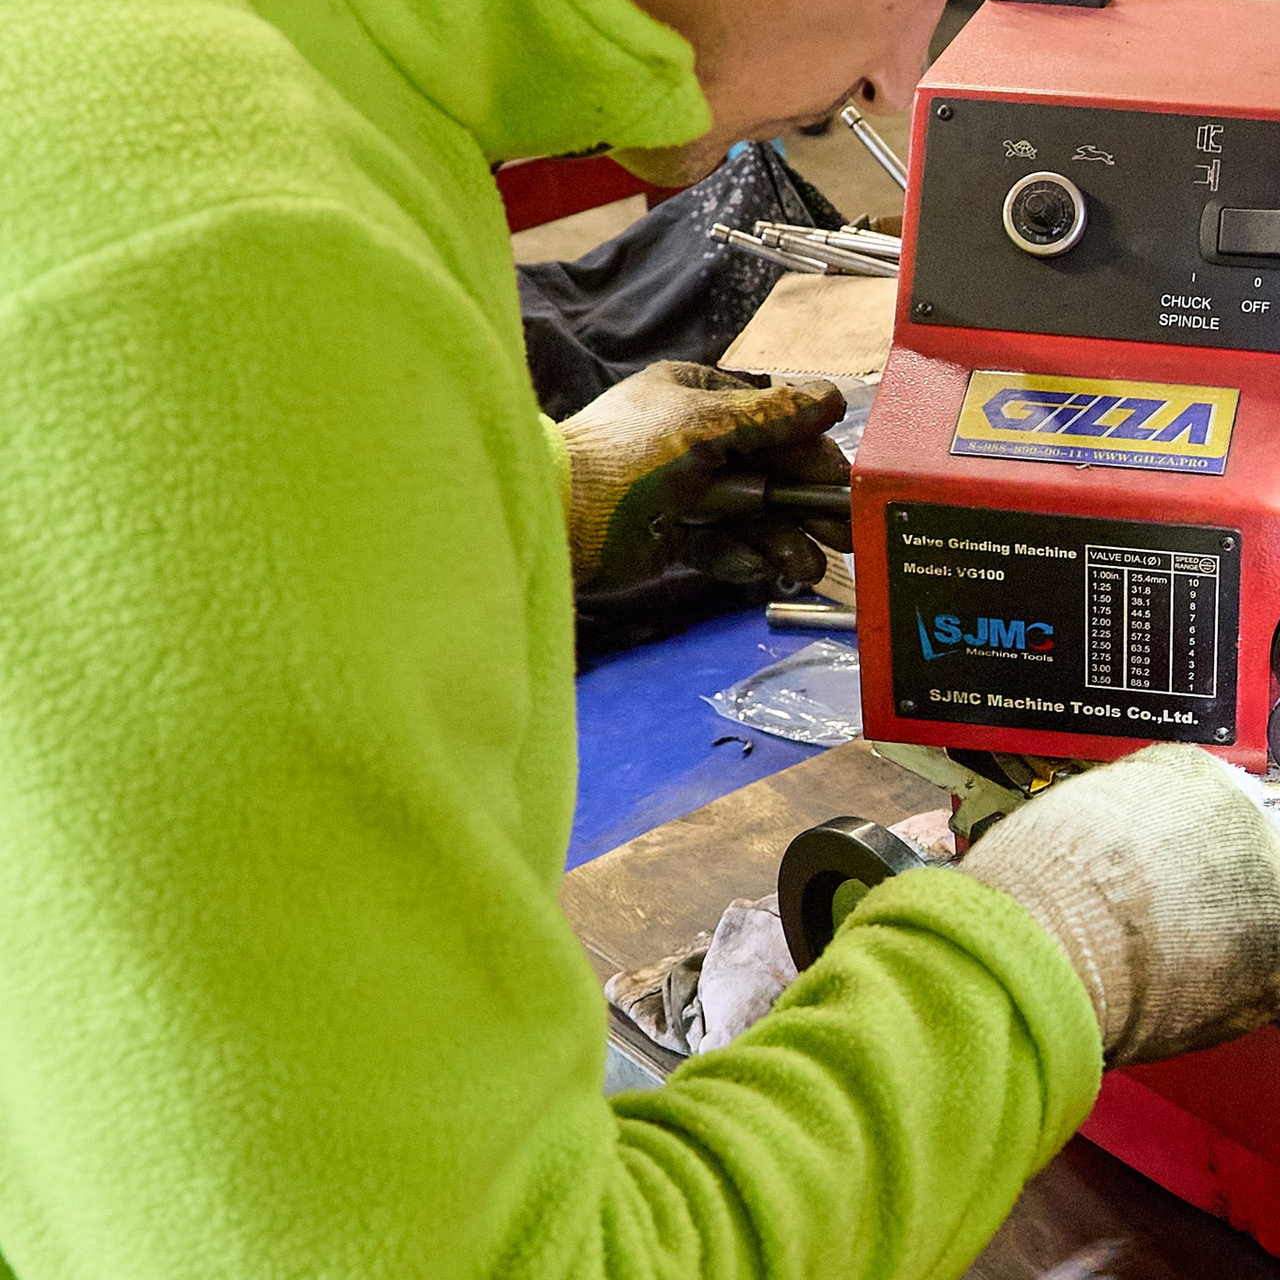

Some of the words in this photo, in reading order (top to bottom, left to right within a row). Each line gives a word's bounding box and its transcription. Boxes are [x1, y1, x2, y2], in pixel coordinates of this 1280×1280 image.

[1160, 294, 1212, 310] CHUCK
[1241, 300, 1270, 313] OFF
[1159, 313, 1220, 330] SPINDLE
[1093, 451, 1209, 468] WWW.GILZA.PRO
[902, 533, 944, 548] Valve
[948, 538, 1011, 556] Grinding
[1014, 543, 1078, 559] Machine
[1090, 551, 1122, 562] VALVE
[1175, 556, 1200, 564] SPEED
[903, 562, 952, 577] Model:
[956, 565, 1005, 581] VG100
[1174, 563, 1200, 571] RANGE
[1131, 573, 1168, 584] 25.4mm
[1188, 578, 1199, 587] 10
[1092, 582, 1112, 591] 1.25
[1131, 586, 1151, 595] 31.8
[1190, 590, 1197, 599] 9
[1092, 594, 1112, 603] 1.50
[1131, 597, 1150, 606] 38.1
[1189, 602, 1196, 611] 8
[1092, 606, 1112, 615] 1.75
[1131, 609, 1151, 618] 44.5
[1189, 614, 1196, 622] 7
[1091, 617, 1112, 627] 2.00
[1131, 621, 1151, 630] 50.8
[1189, 625, 1196, 634] 6
[1091, 629, 1111, 638] 2.25
[1131, 632, 1151, 642] 57.2
[1189, 637, 1196, 646] 5
[966, 647, 1018, 659] Machine
[1021, 652, 1054, 662] Tools
[1091, 640, 1111, 650] 2.50
[1131, 644, 1150, 653] 63.5
[1188, 649, 1195, 658] 4
[1091, 652, 1111, 661] 2.75
[1130, 655, 1150, 665] 69.9
[1188, 660, 1195, 669] 3
[1091, 663, 1111, 673] 3.00
[1130, 667, 1150, 676] 76.2
[1188, 671, 1195, 680] 2
[1091, 675, 1111, 684] 3.50
[1130, 678, 1150, 688] 88.9
[1188, 683, 1194, 691] 1
[928, 688, 981, 706] SJMC
[987, 694, 1065, 713] Machine
[1070, 701, 1121, 719] Tools
